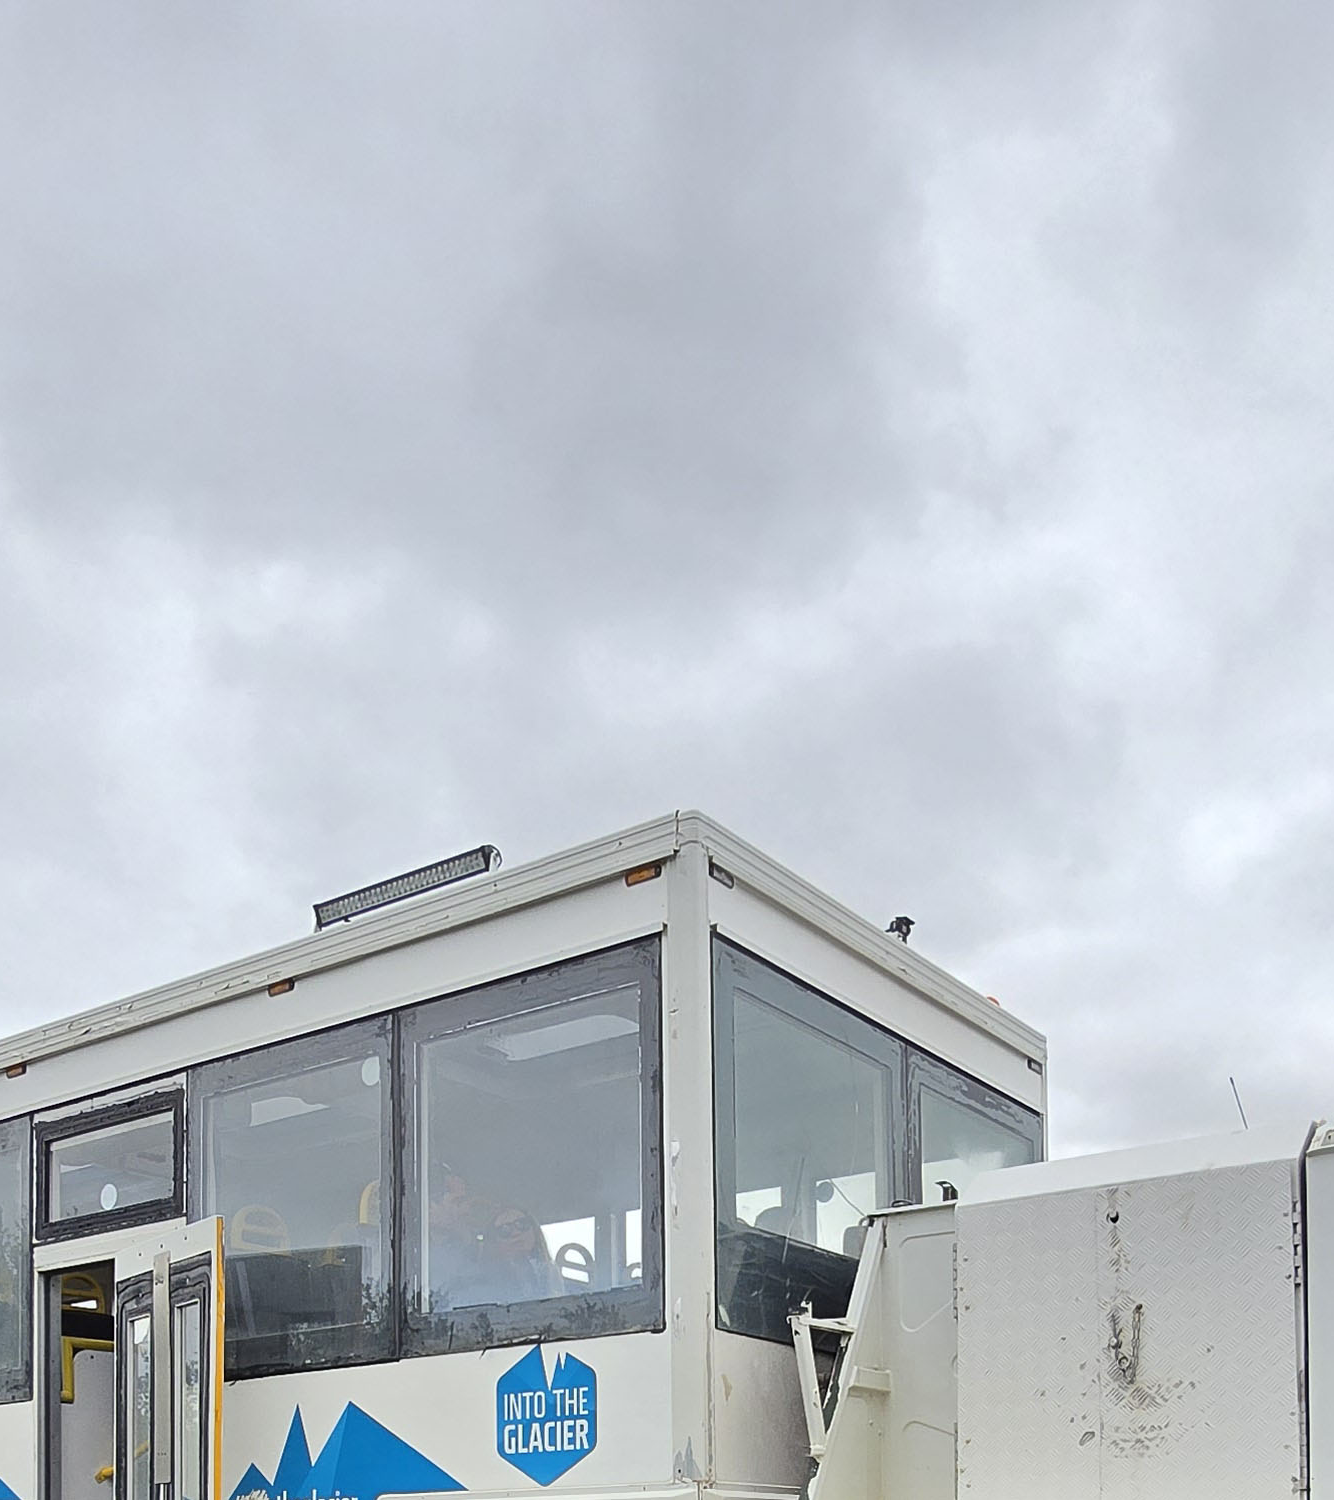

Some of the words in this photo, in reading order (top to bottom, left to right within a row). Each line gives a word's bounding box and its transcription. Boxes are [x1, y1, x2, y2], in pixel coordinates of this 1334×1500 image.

[504, 1391, 545, 1421] INTO
[552, 1387, 589, 1417] THE
[504, 1419, 589, 1455] GLACIER
